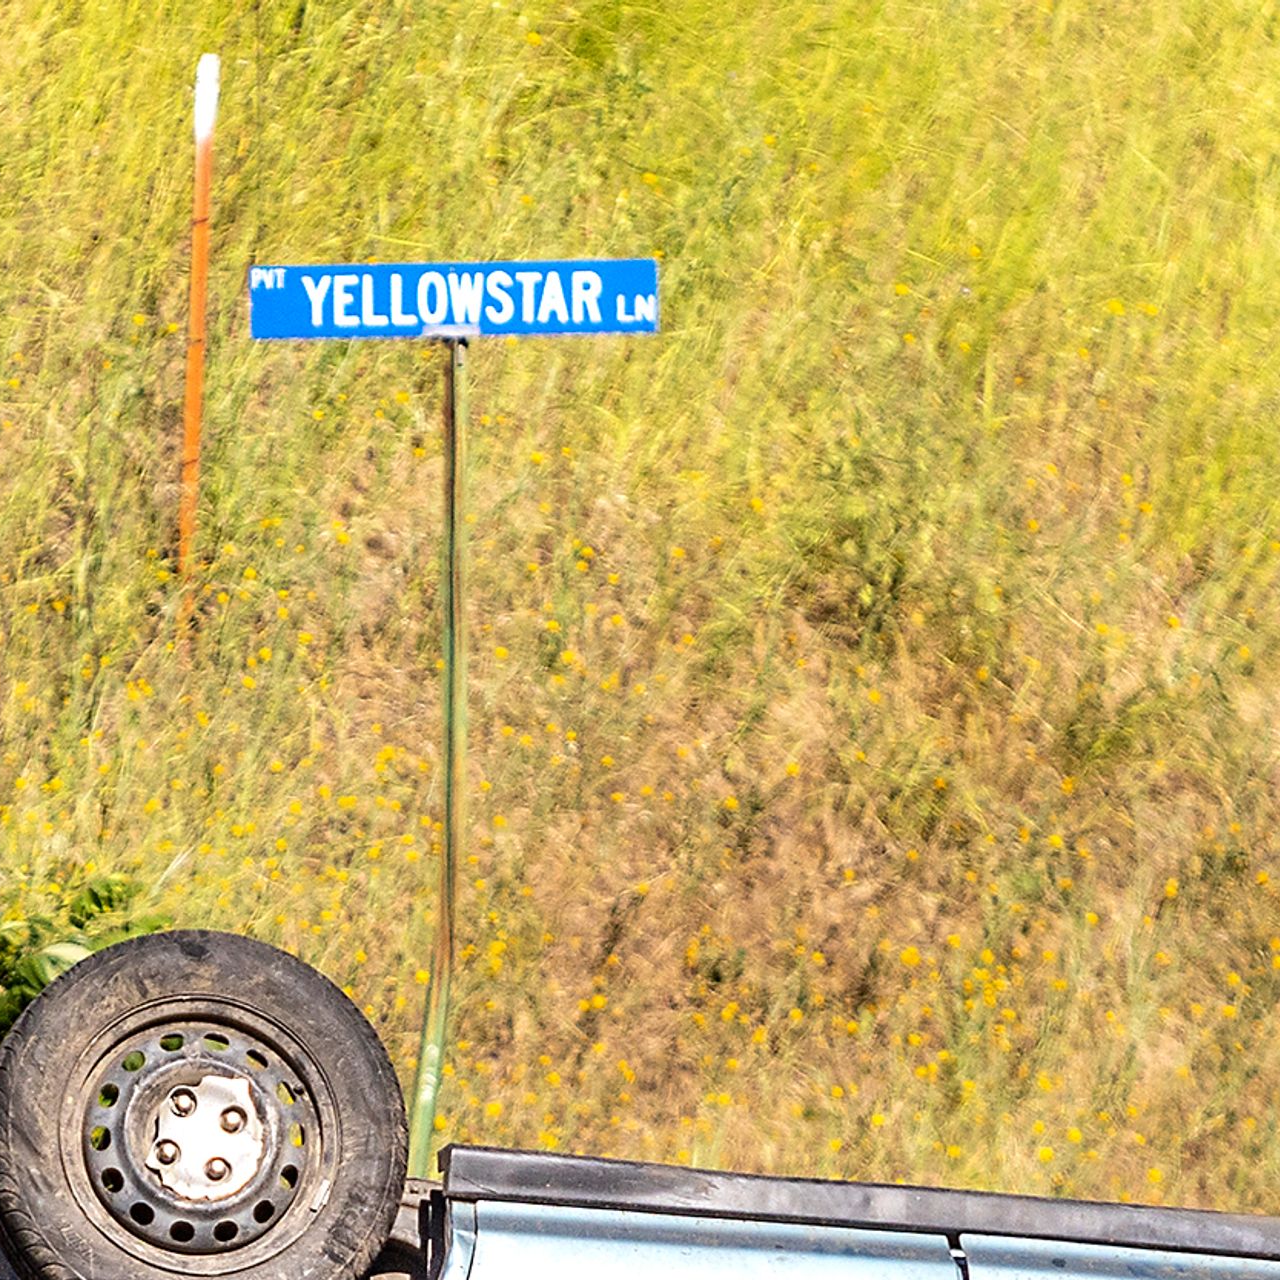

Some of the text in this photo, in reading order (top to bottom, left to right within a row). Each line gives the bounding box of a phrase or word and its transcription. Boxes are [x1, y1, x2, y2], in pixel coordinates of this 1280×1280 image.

[250, 268, 656, 327] PVT YELLOWSTAR LN
